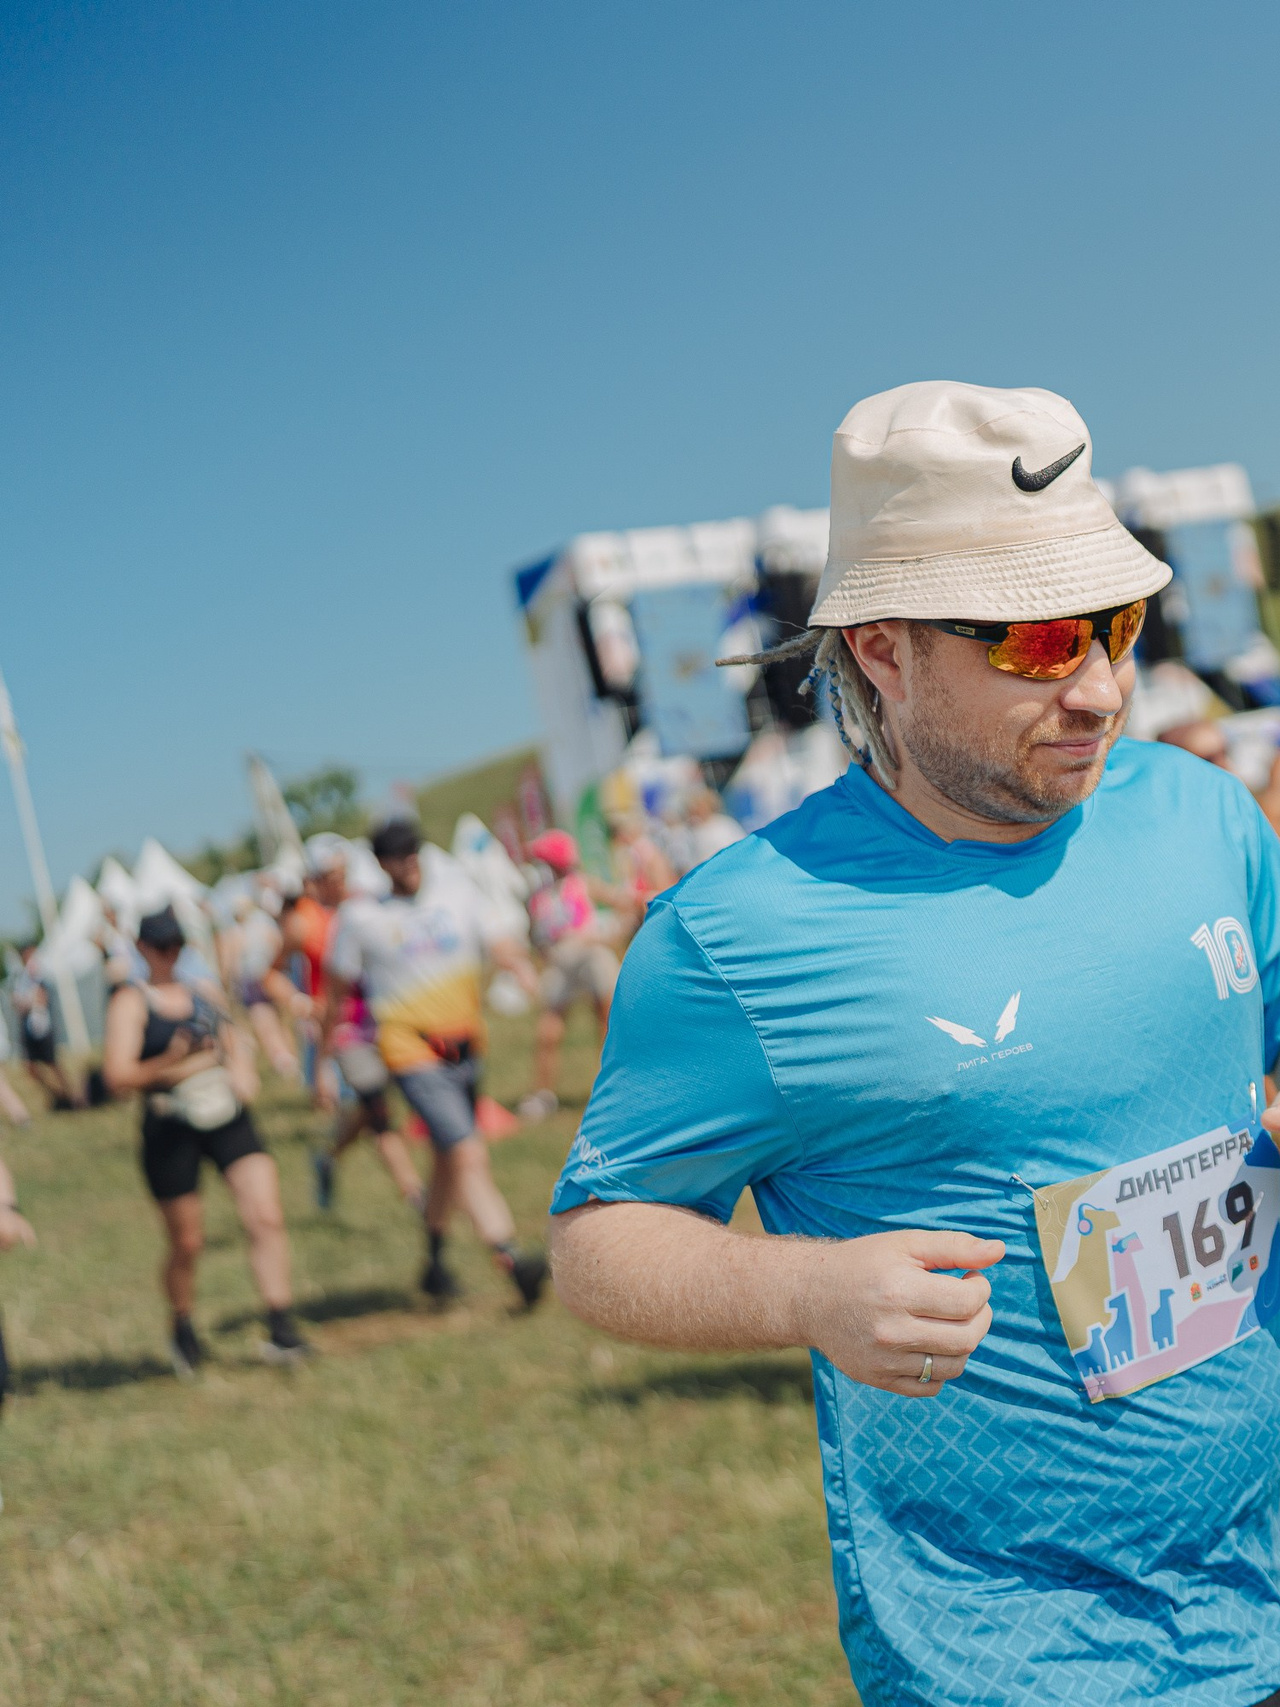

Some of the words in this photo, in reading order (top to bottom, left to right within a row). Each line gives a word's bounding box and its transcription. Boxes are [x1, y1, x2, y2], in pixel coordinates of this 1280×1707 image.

[1190, 916, 1259, 1000] 10
[957, 1056, 989, 1071] ЛИГА
[991, 1042, 1034, 1061] ГЕРОЕВ
[1162, 1180, 1257, 1279] 169
